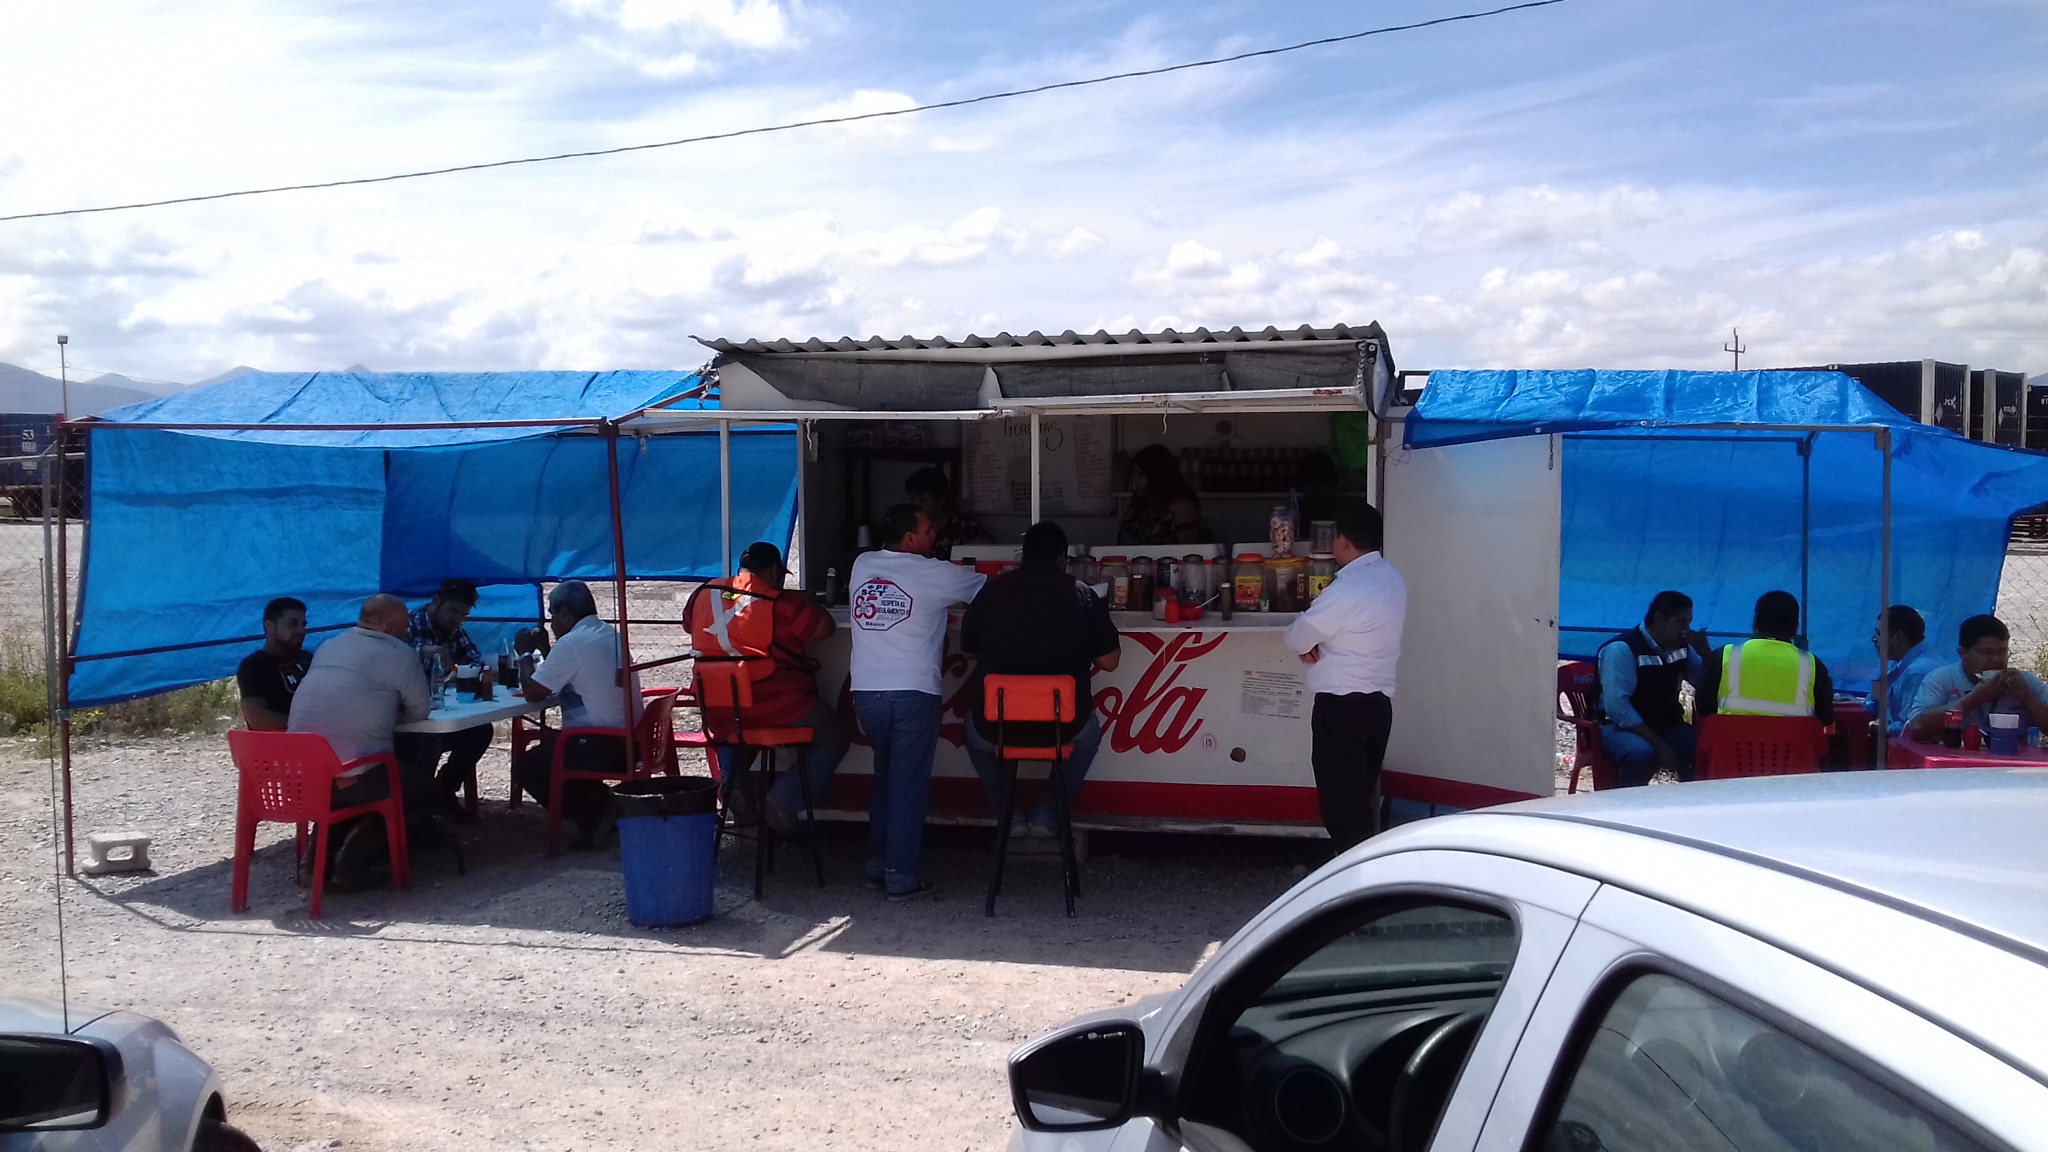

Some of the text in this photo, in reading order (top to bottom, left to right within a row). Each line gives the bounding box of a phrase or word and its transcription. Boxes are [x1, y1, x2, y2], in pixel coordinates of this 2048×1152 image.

[22, 429, 34, 440] 53
[855, 595, 877, 619] 85
[877, 607, 905, 615] REGLAMENTO
